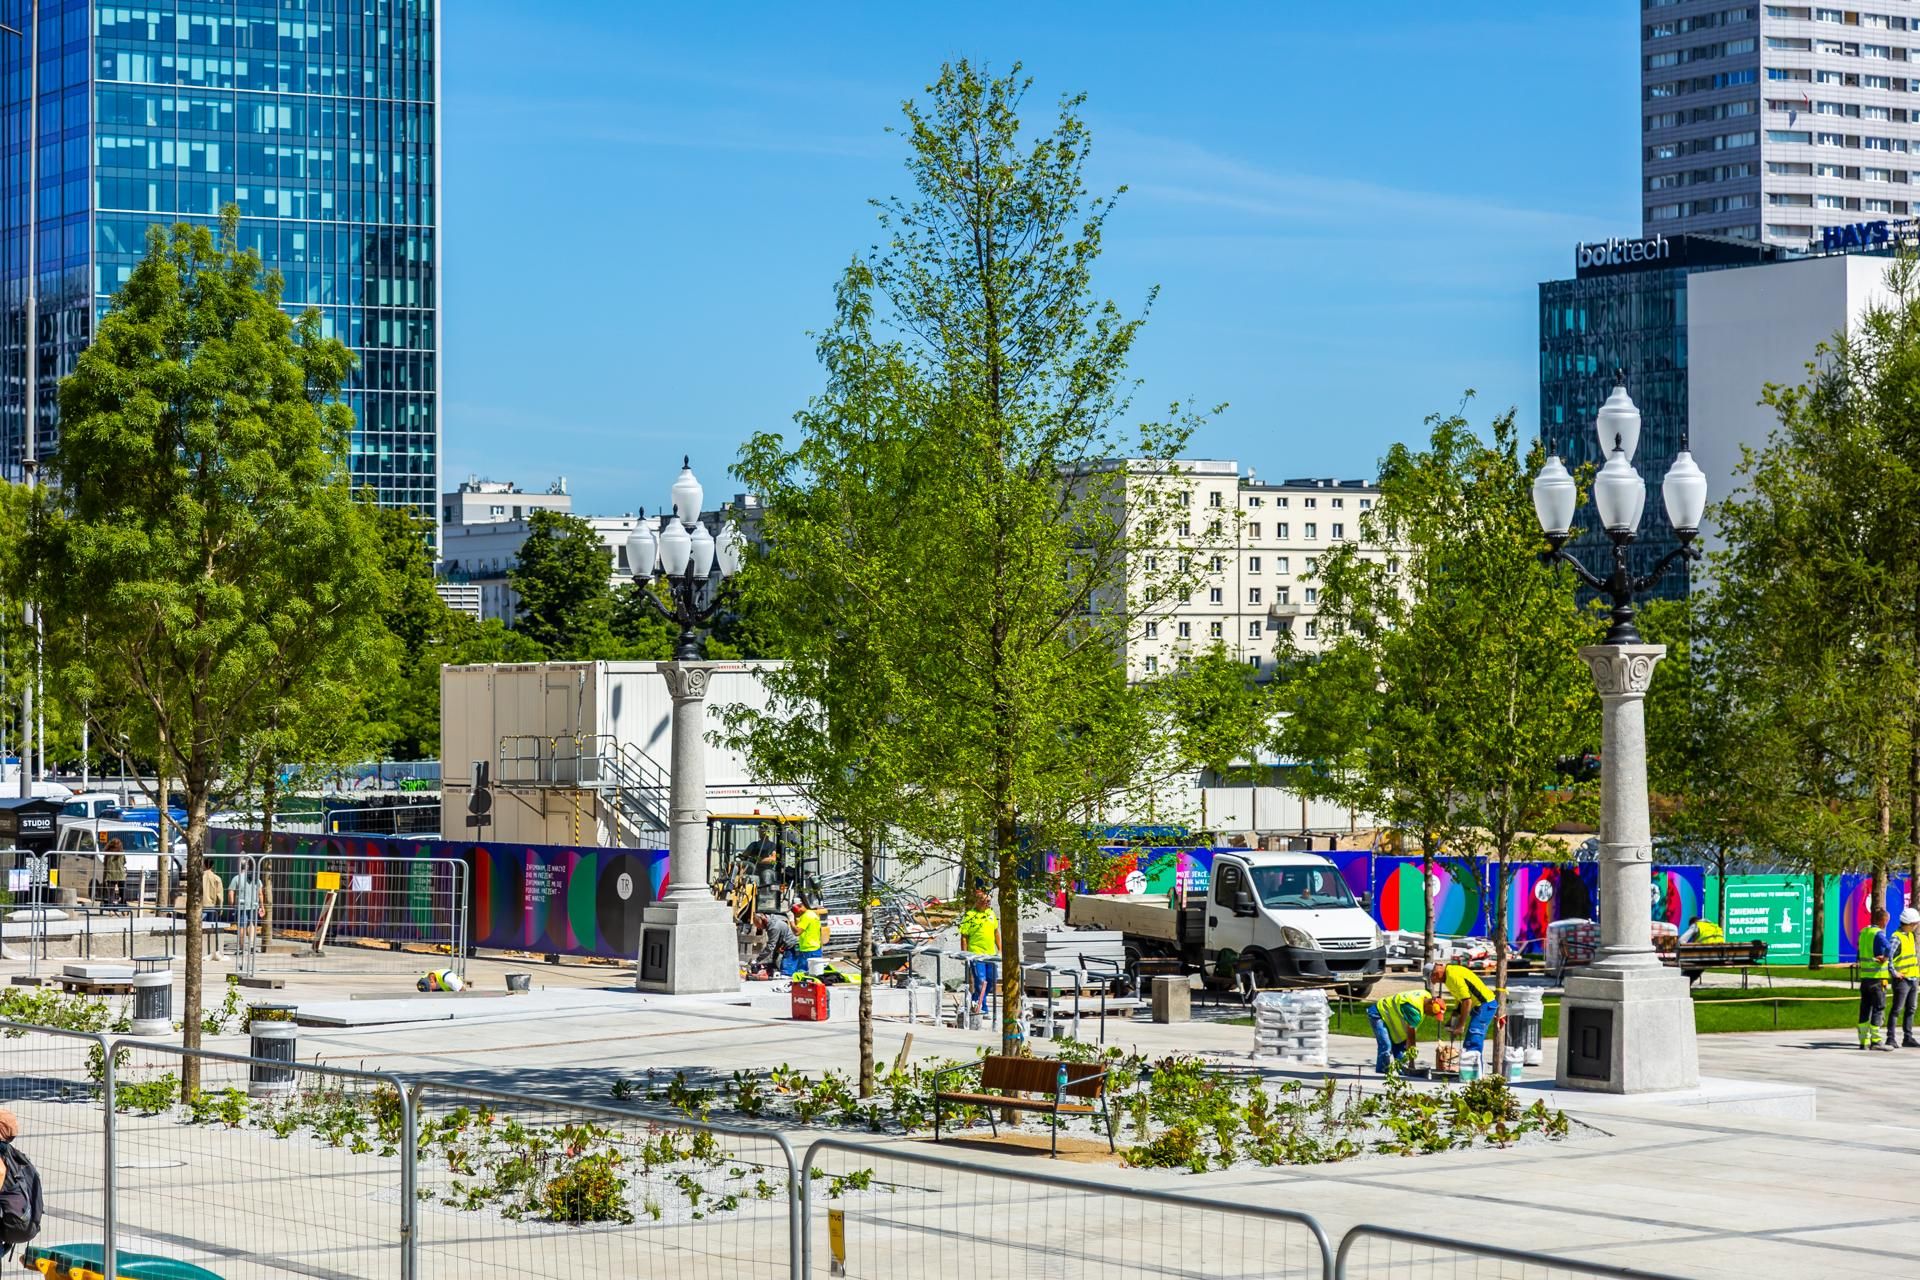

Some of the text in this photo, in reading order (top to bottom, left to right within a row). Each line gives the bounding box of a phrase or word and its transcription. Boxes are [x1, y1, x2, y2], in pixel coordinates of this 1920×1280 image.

[1823, 220, 1889, 248] HAYS
[1578, 233, 1669, 269] bolttech
[22, 819, 51, 827] STUDIO
[620, 878, 630, 892] TR
[1729, 907, 1770, 916] ZMIENIAMY
[1728, 926, 1769, 935] DLA CIEBIE
